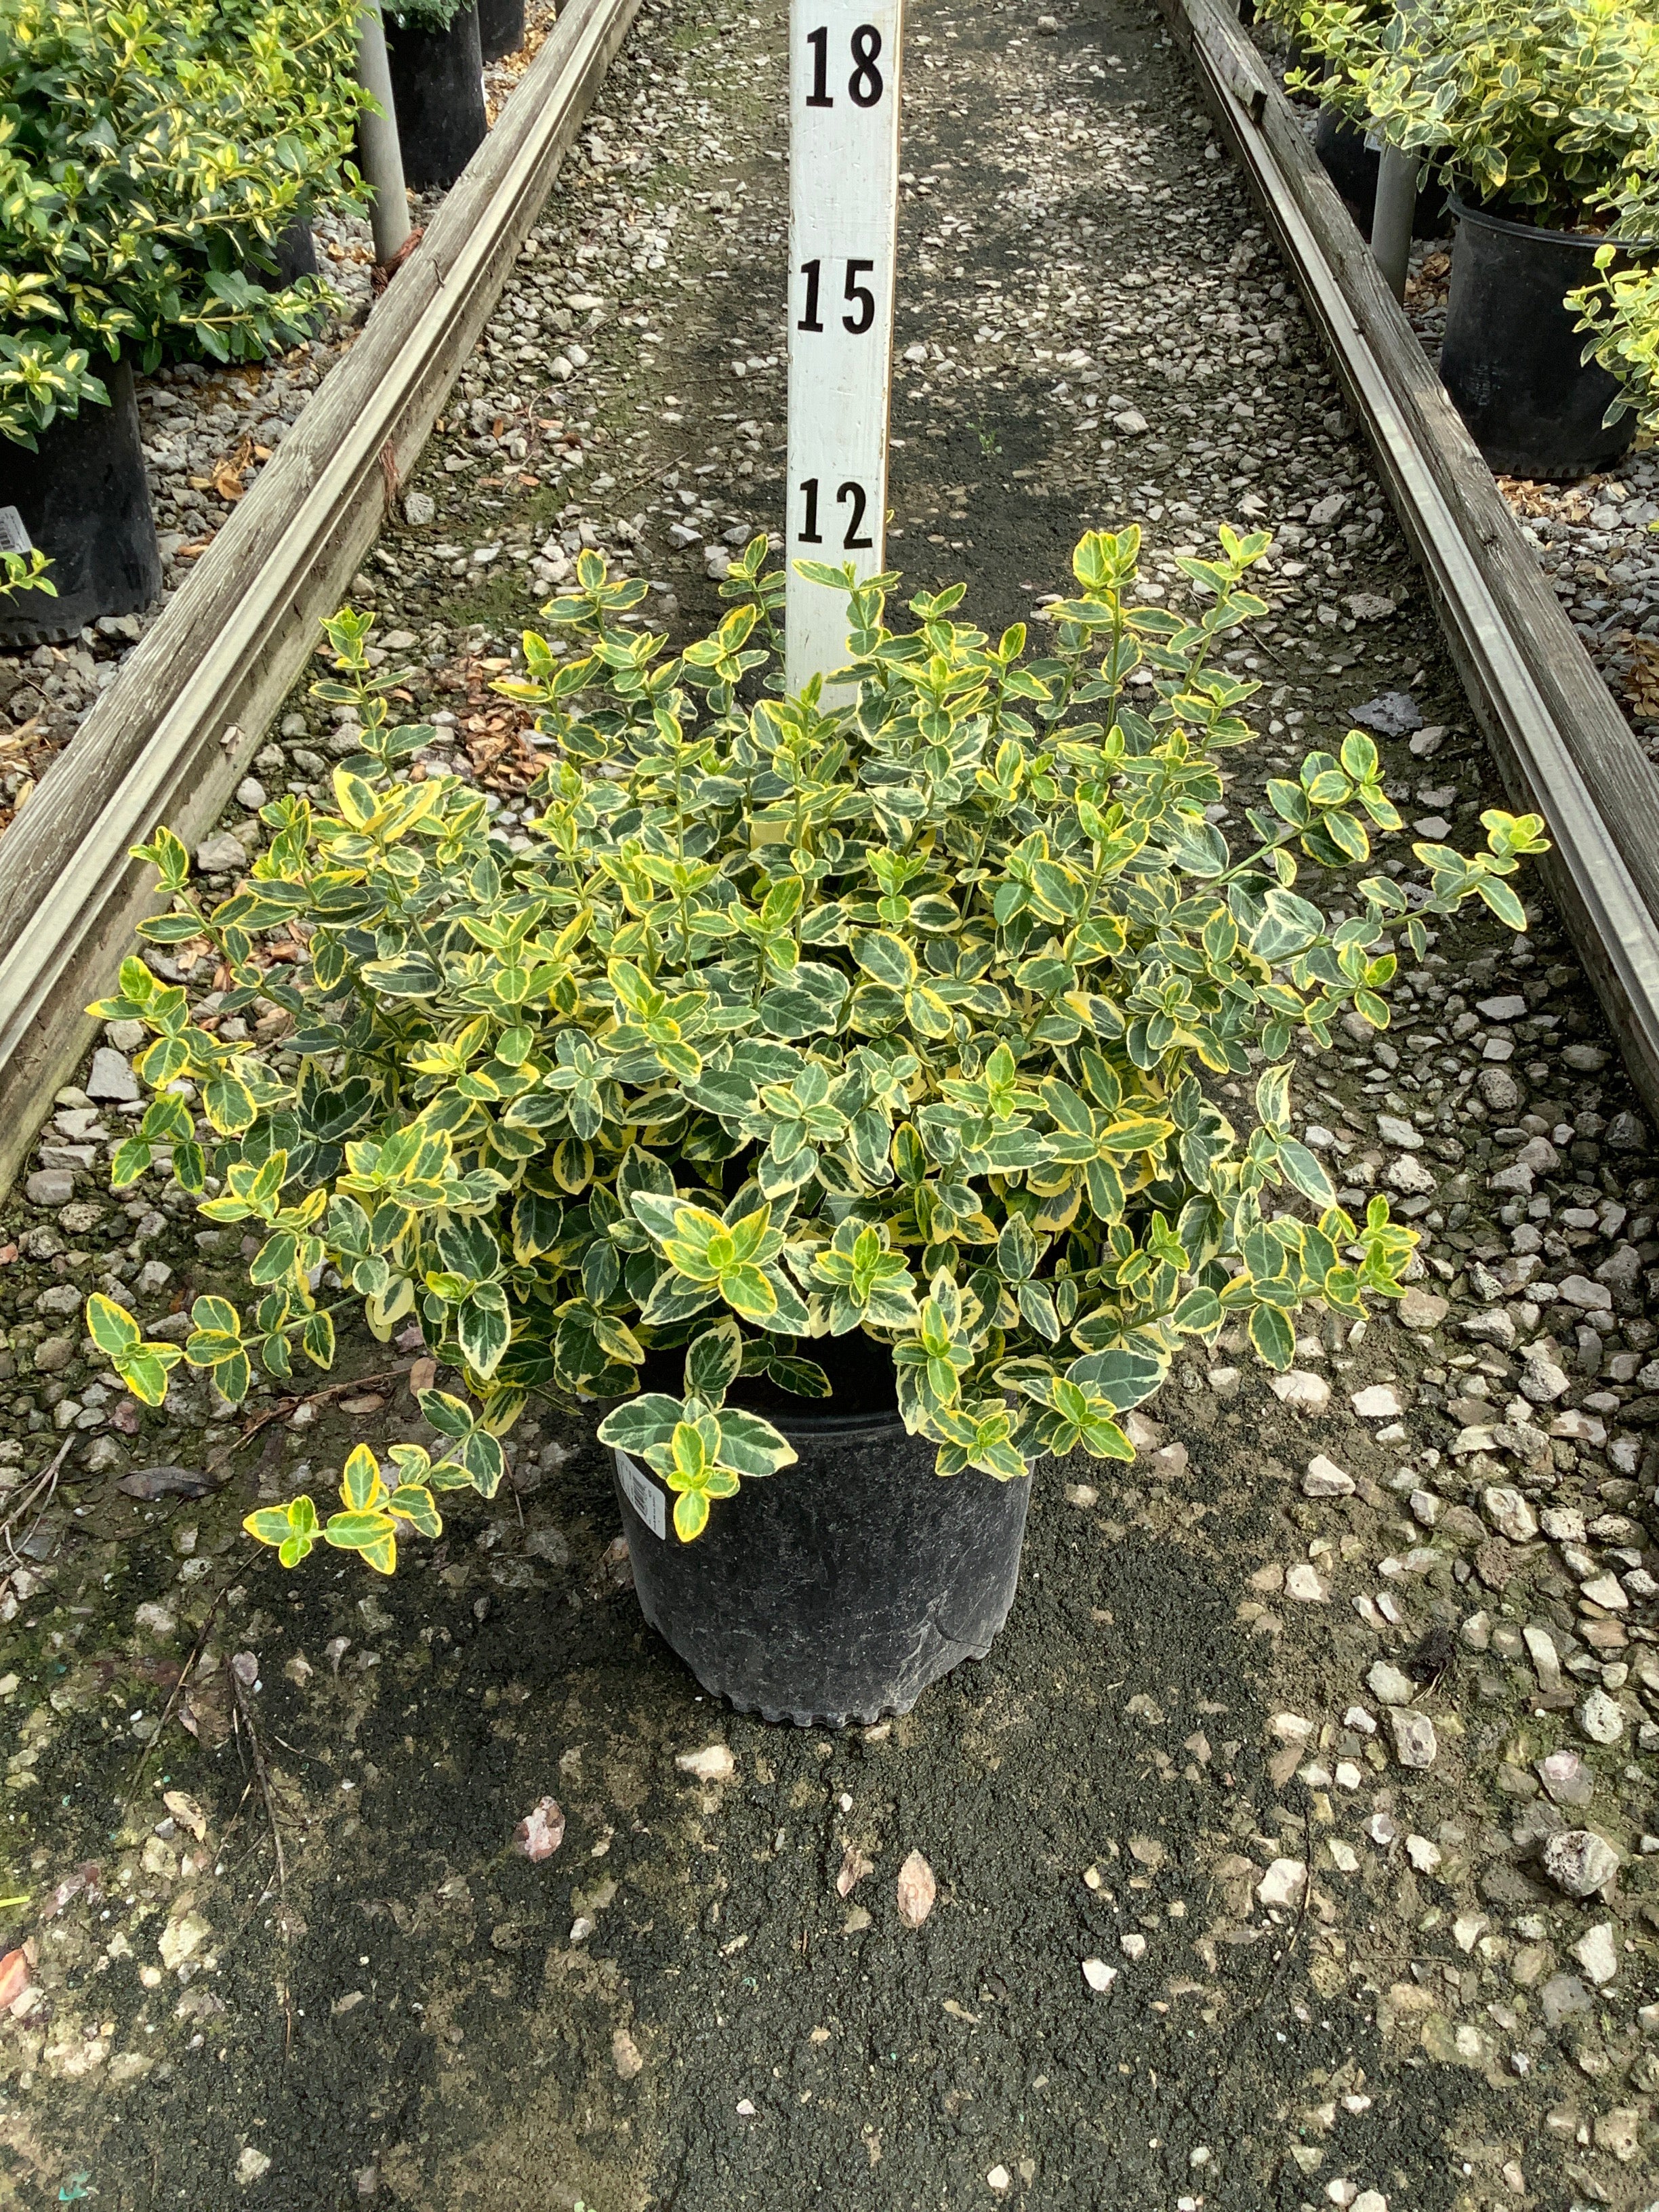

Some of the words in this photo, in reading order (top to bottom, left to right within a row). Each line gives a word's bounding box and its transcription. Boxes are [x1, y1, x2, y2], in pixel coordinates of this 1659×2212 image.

[806, 24, 883, 108] 18
[798, 259, 875, 335] 15
[798, 478, 873, 550] 12
